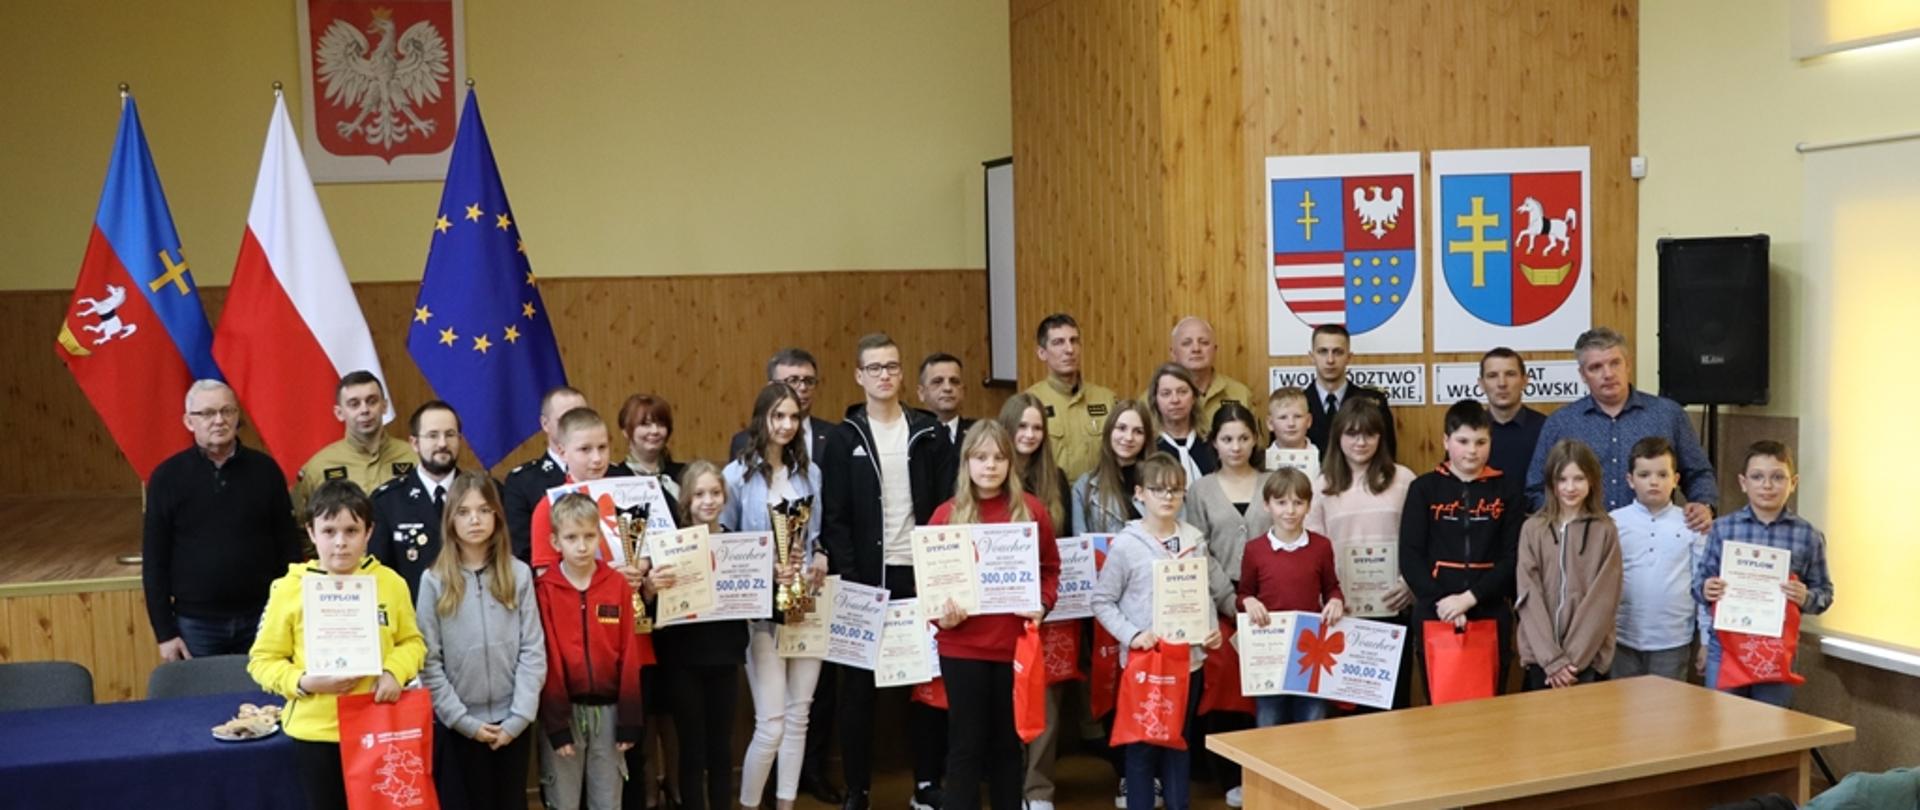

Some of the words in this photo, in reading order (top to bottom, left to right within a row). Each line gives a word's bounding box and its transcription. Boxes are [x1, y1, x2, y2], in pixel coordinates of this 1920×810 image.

[664, 544, 698, 556] DYPLOM
[927, 543, 960, 553] DYPLOM
[979, 538, 1033, 554] Voucher
[1737, 559, 1774, 569] DYPLOM
[982, 571, 1017, 585] 300,00
[1020, 571, 1034, 583] ZŁ
[716, 580, 750, 592] 500,00
[753, 579, 767, 590] ZŁ
[320, 593, 360, 602] DYPLOM
[833, 592, 881, 614] Voucher
[1347, 631, 1397, 653] Voucher
[1341, 663, 1377, 679] 300,00
[1378, 669, 1392, 682] ZŁ
